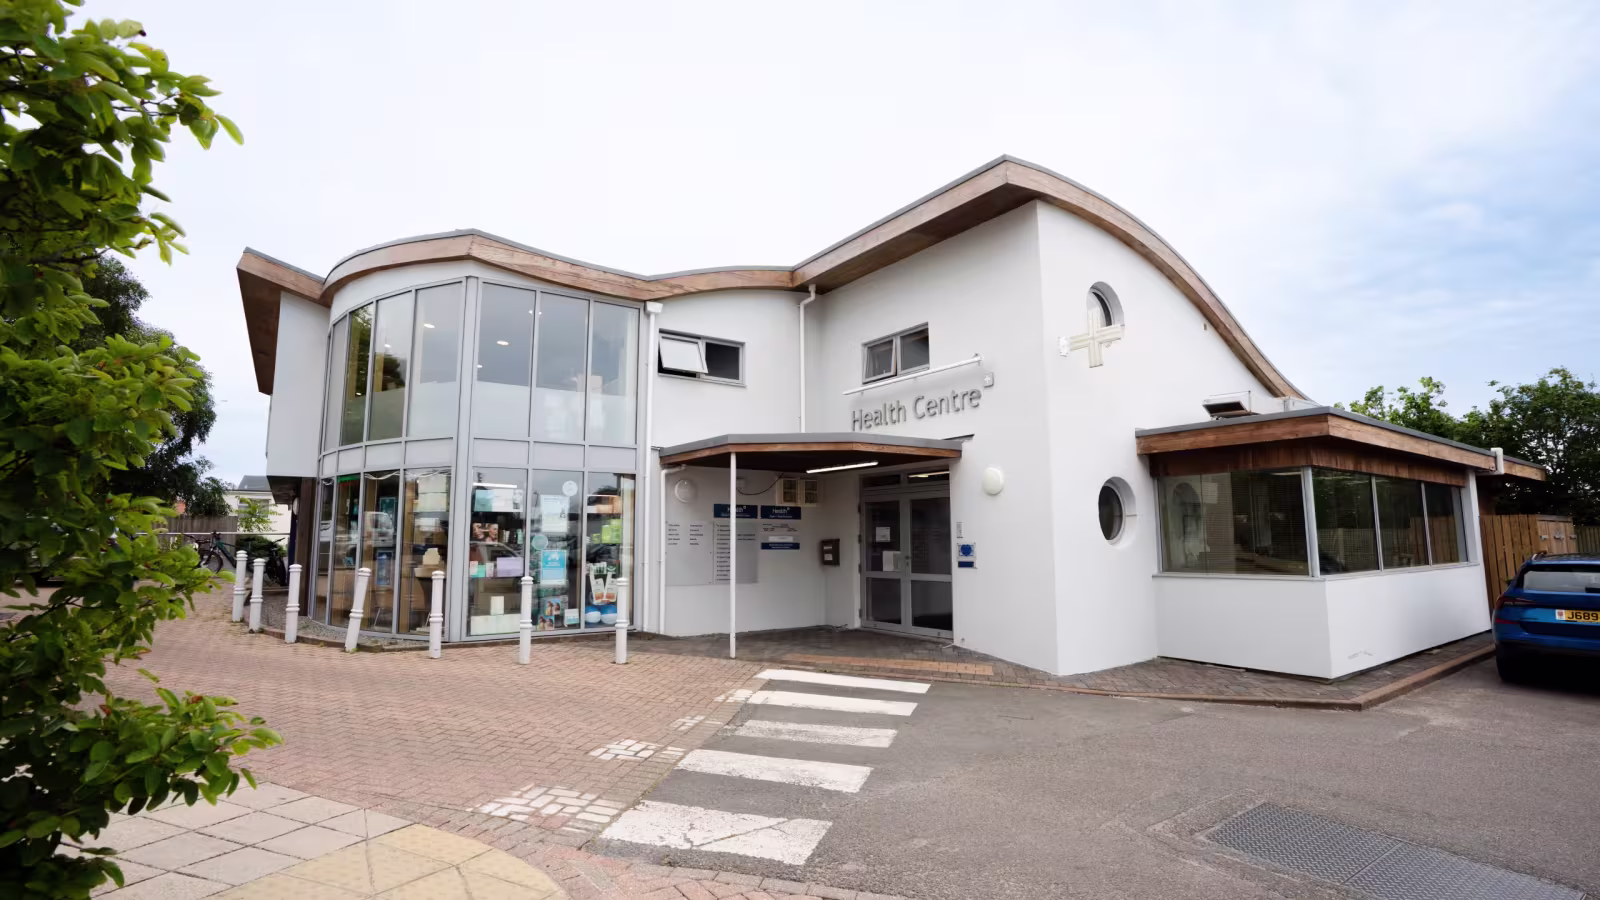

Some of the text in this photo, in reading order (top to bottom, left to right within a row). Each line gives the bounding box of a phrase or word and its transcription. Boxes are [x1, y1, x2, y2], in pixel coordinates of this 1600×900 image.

[852, 388, 982, 431] Health Centre
[1567, 611, 1599, 620] J689
